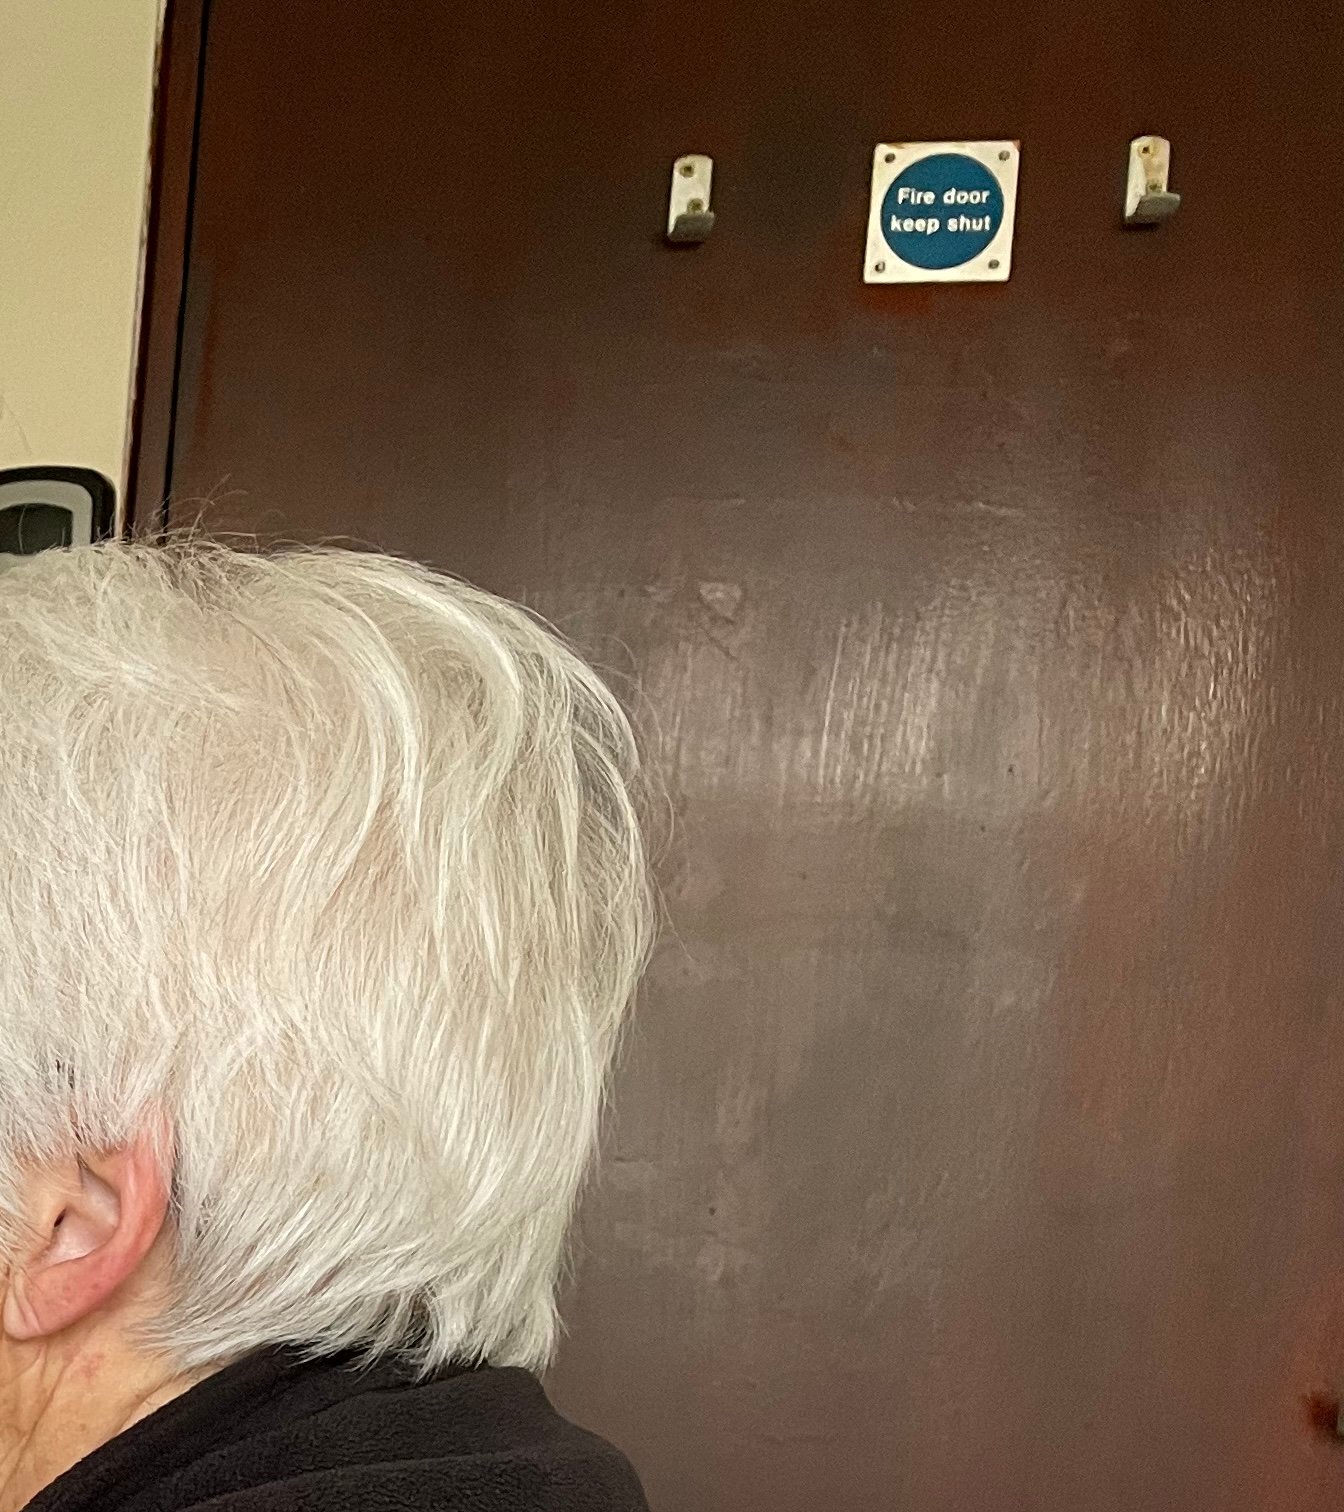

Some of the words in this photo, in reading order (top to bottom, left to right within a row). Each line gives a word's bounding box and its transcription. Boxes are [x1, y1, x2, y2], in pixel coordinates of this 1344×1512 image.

[898, 188, 936, 205] Fire
[943, 188, 990, 205] door
[890, 215, 940, 235] keep
[948, 214, 990, 232] shut
